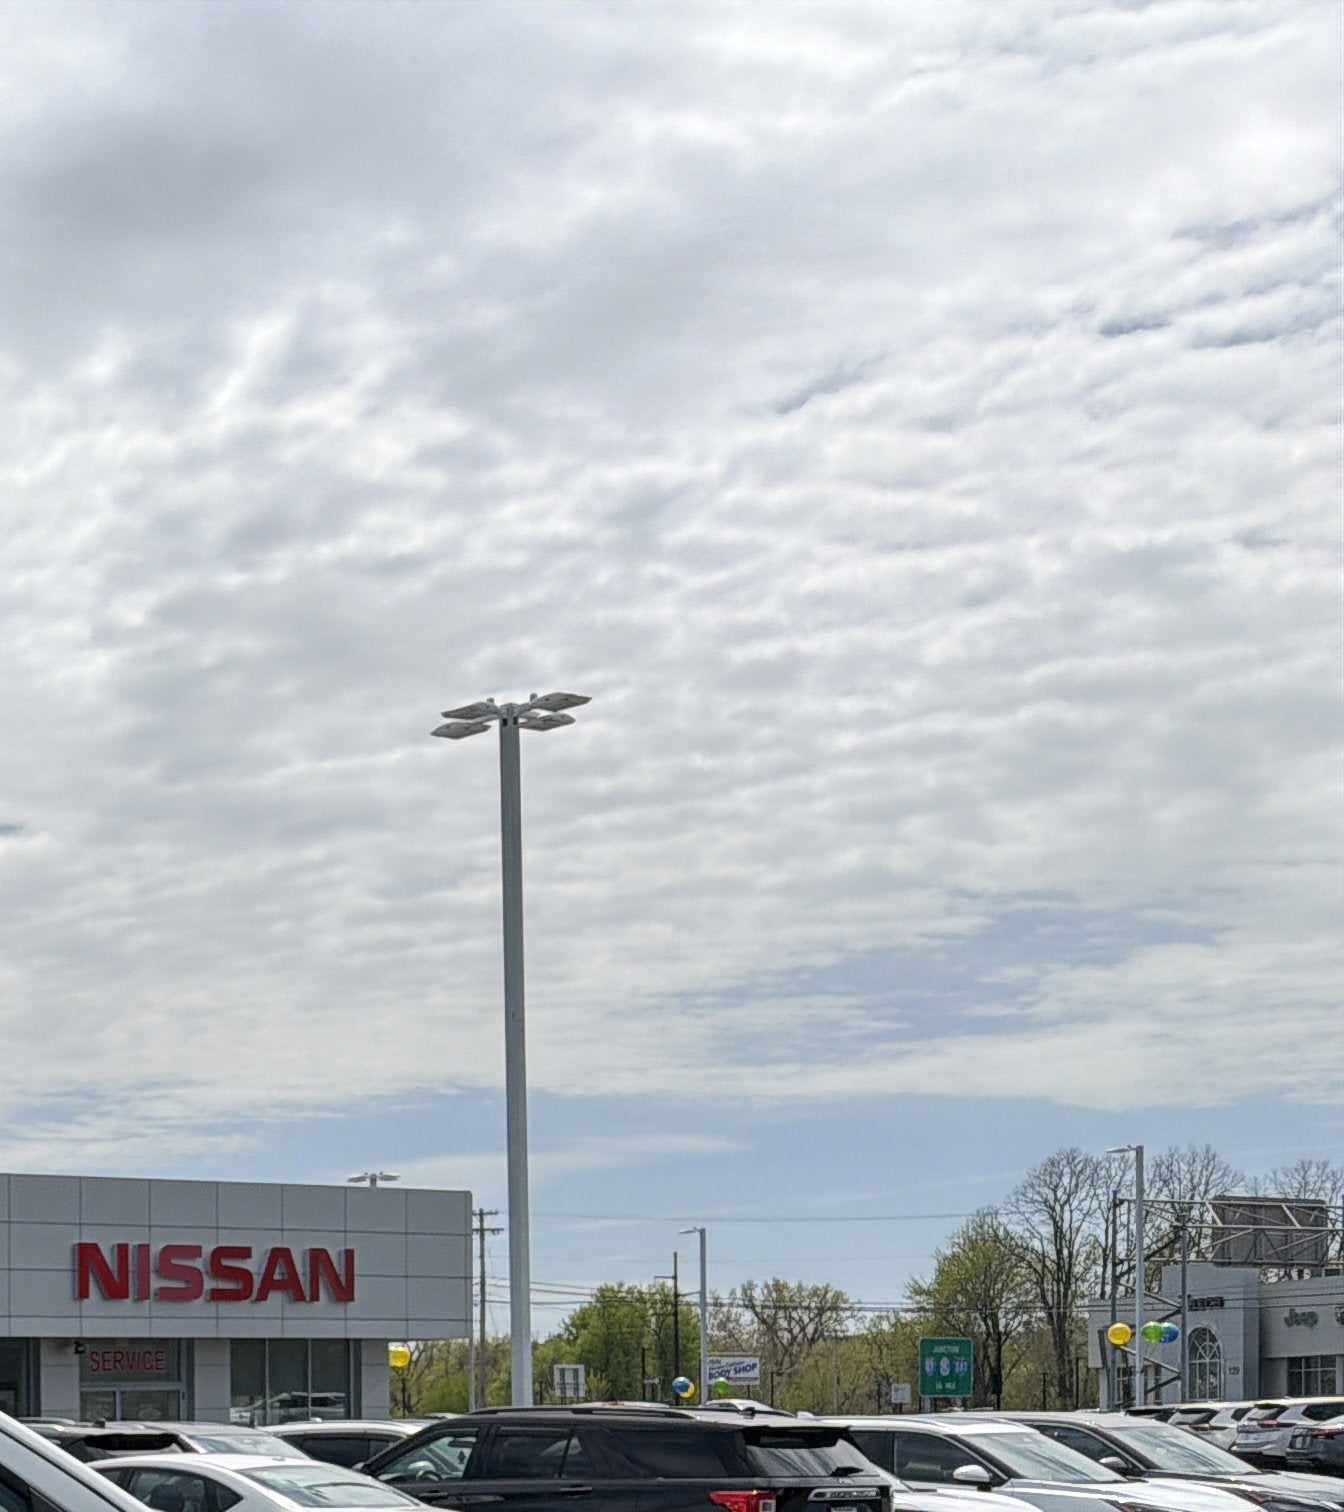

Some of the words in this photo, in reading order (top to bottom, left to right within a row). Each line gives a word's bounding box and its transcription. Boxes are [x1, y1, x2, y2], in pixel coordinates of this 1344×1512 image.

[76, 1242, 356, 1302] NISSAN
[1284, 1307, 1319, 1328] Jeep
[89, 1350, 166, 1372] SERVICE
[733, 1362, 758, 1376] SHOP
